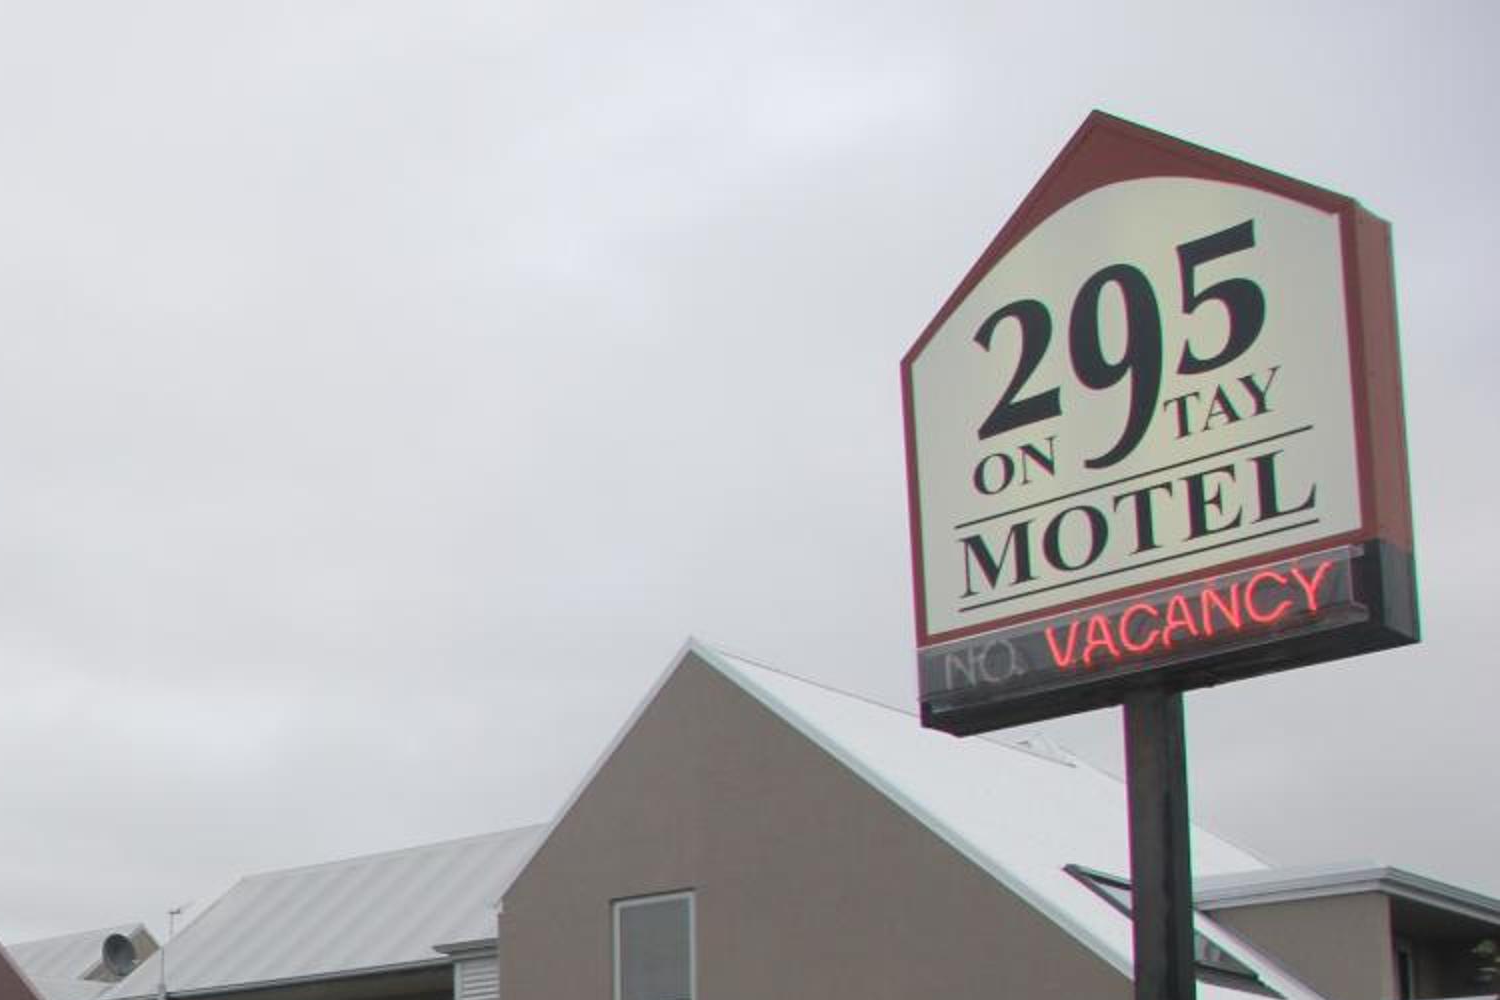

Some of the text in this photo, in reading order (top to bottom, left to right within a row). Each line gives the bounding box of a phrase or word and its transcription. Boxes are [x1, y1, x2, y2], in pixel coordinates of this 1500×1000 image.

[974, 219, 1266, 469] 295
[973, 366, 1281, 495] ON TAY
[959, 450, 1318, 598] MOTEL
[944, 560, 1334, 691] NO VACANCY
